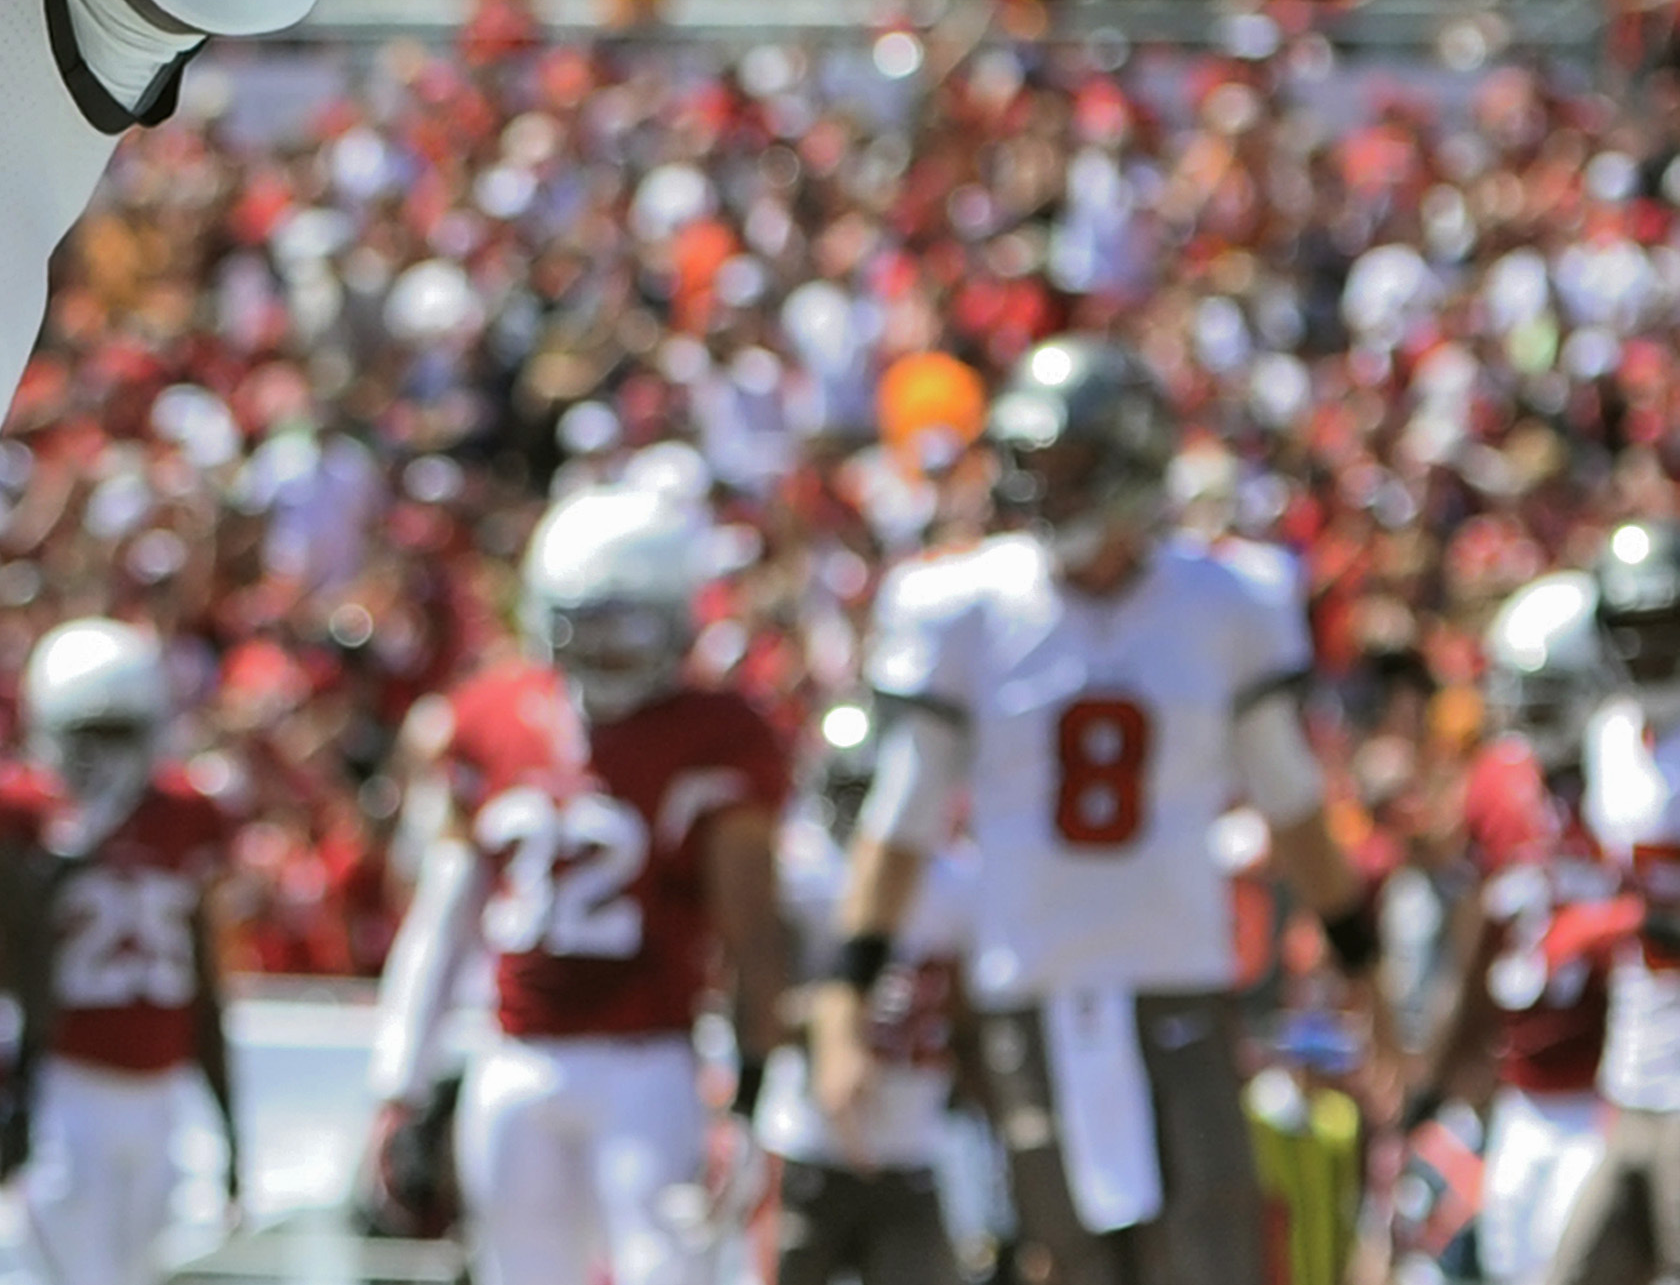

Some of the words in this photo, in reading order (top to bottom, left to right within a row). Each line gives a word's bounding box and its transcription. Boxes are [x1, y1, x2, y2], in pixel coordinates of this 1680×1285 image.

[1056, 698, 1150, 849] 8
[53, 868, 196, 1008] 25
[473, 788, 648, 959] 32
